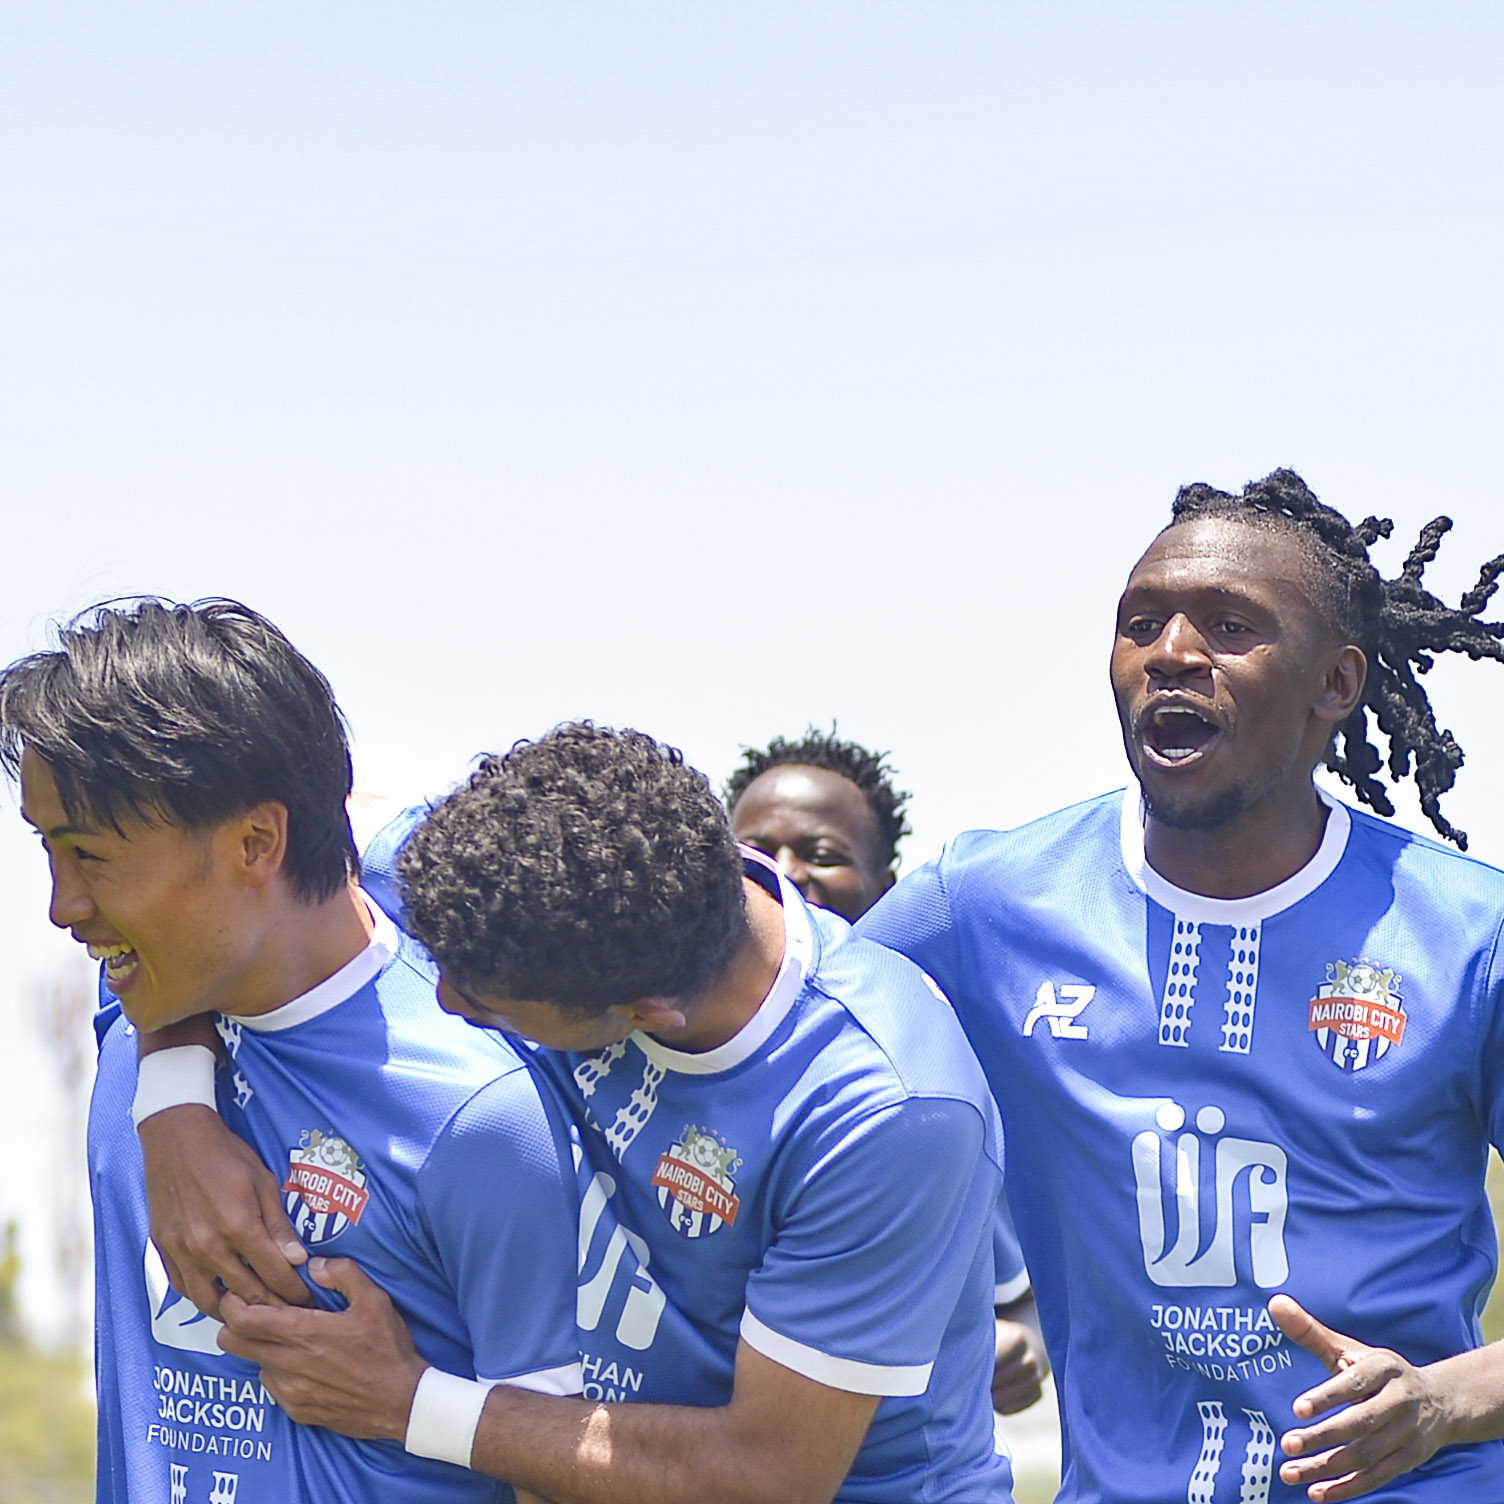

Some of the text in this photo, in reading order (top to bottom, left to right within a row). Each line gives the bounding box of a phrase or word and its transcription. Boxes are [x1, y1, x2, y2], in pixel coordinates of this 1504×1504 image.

[1312, 1002, 1401, 1035] NAIROBI CITY
[1338, 1022, 1371, 1039] STARS
[1344, 1048, 1358, 1059] FC
[289, 1167, 363, 1212] NIROBI CITY
[656, 1161, 734, 1215] NAIROBI CITY
[677, 1188, 704, 1212] STARS
[303, 1219, 315, 1231] FC
[1150, 1304, 1282, 1332] JONATHA
[1161, 1331, 1283, 1357] JACKSON
[1165, 1349, 1293, 1382] FONDATION
[157, 1394, 265, 1433] JACKSON
[146, 1424, 272, 1462] FOUNDATION
